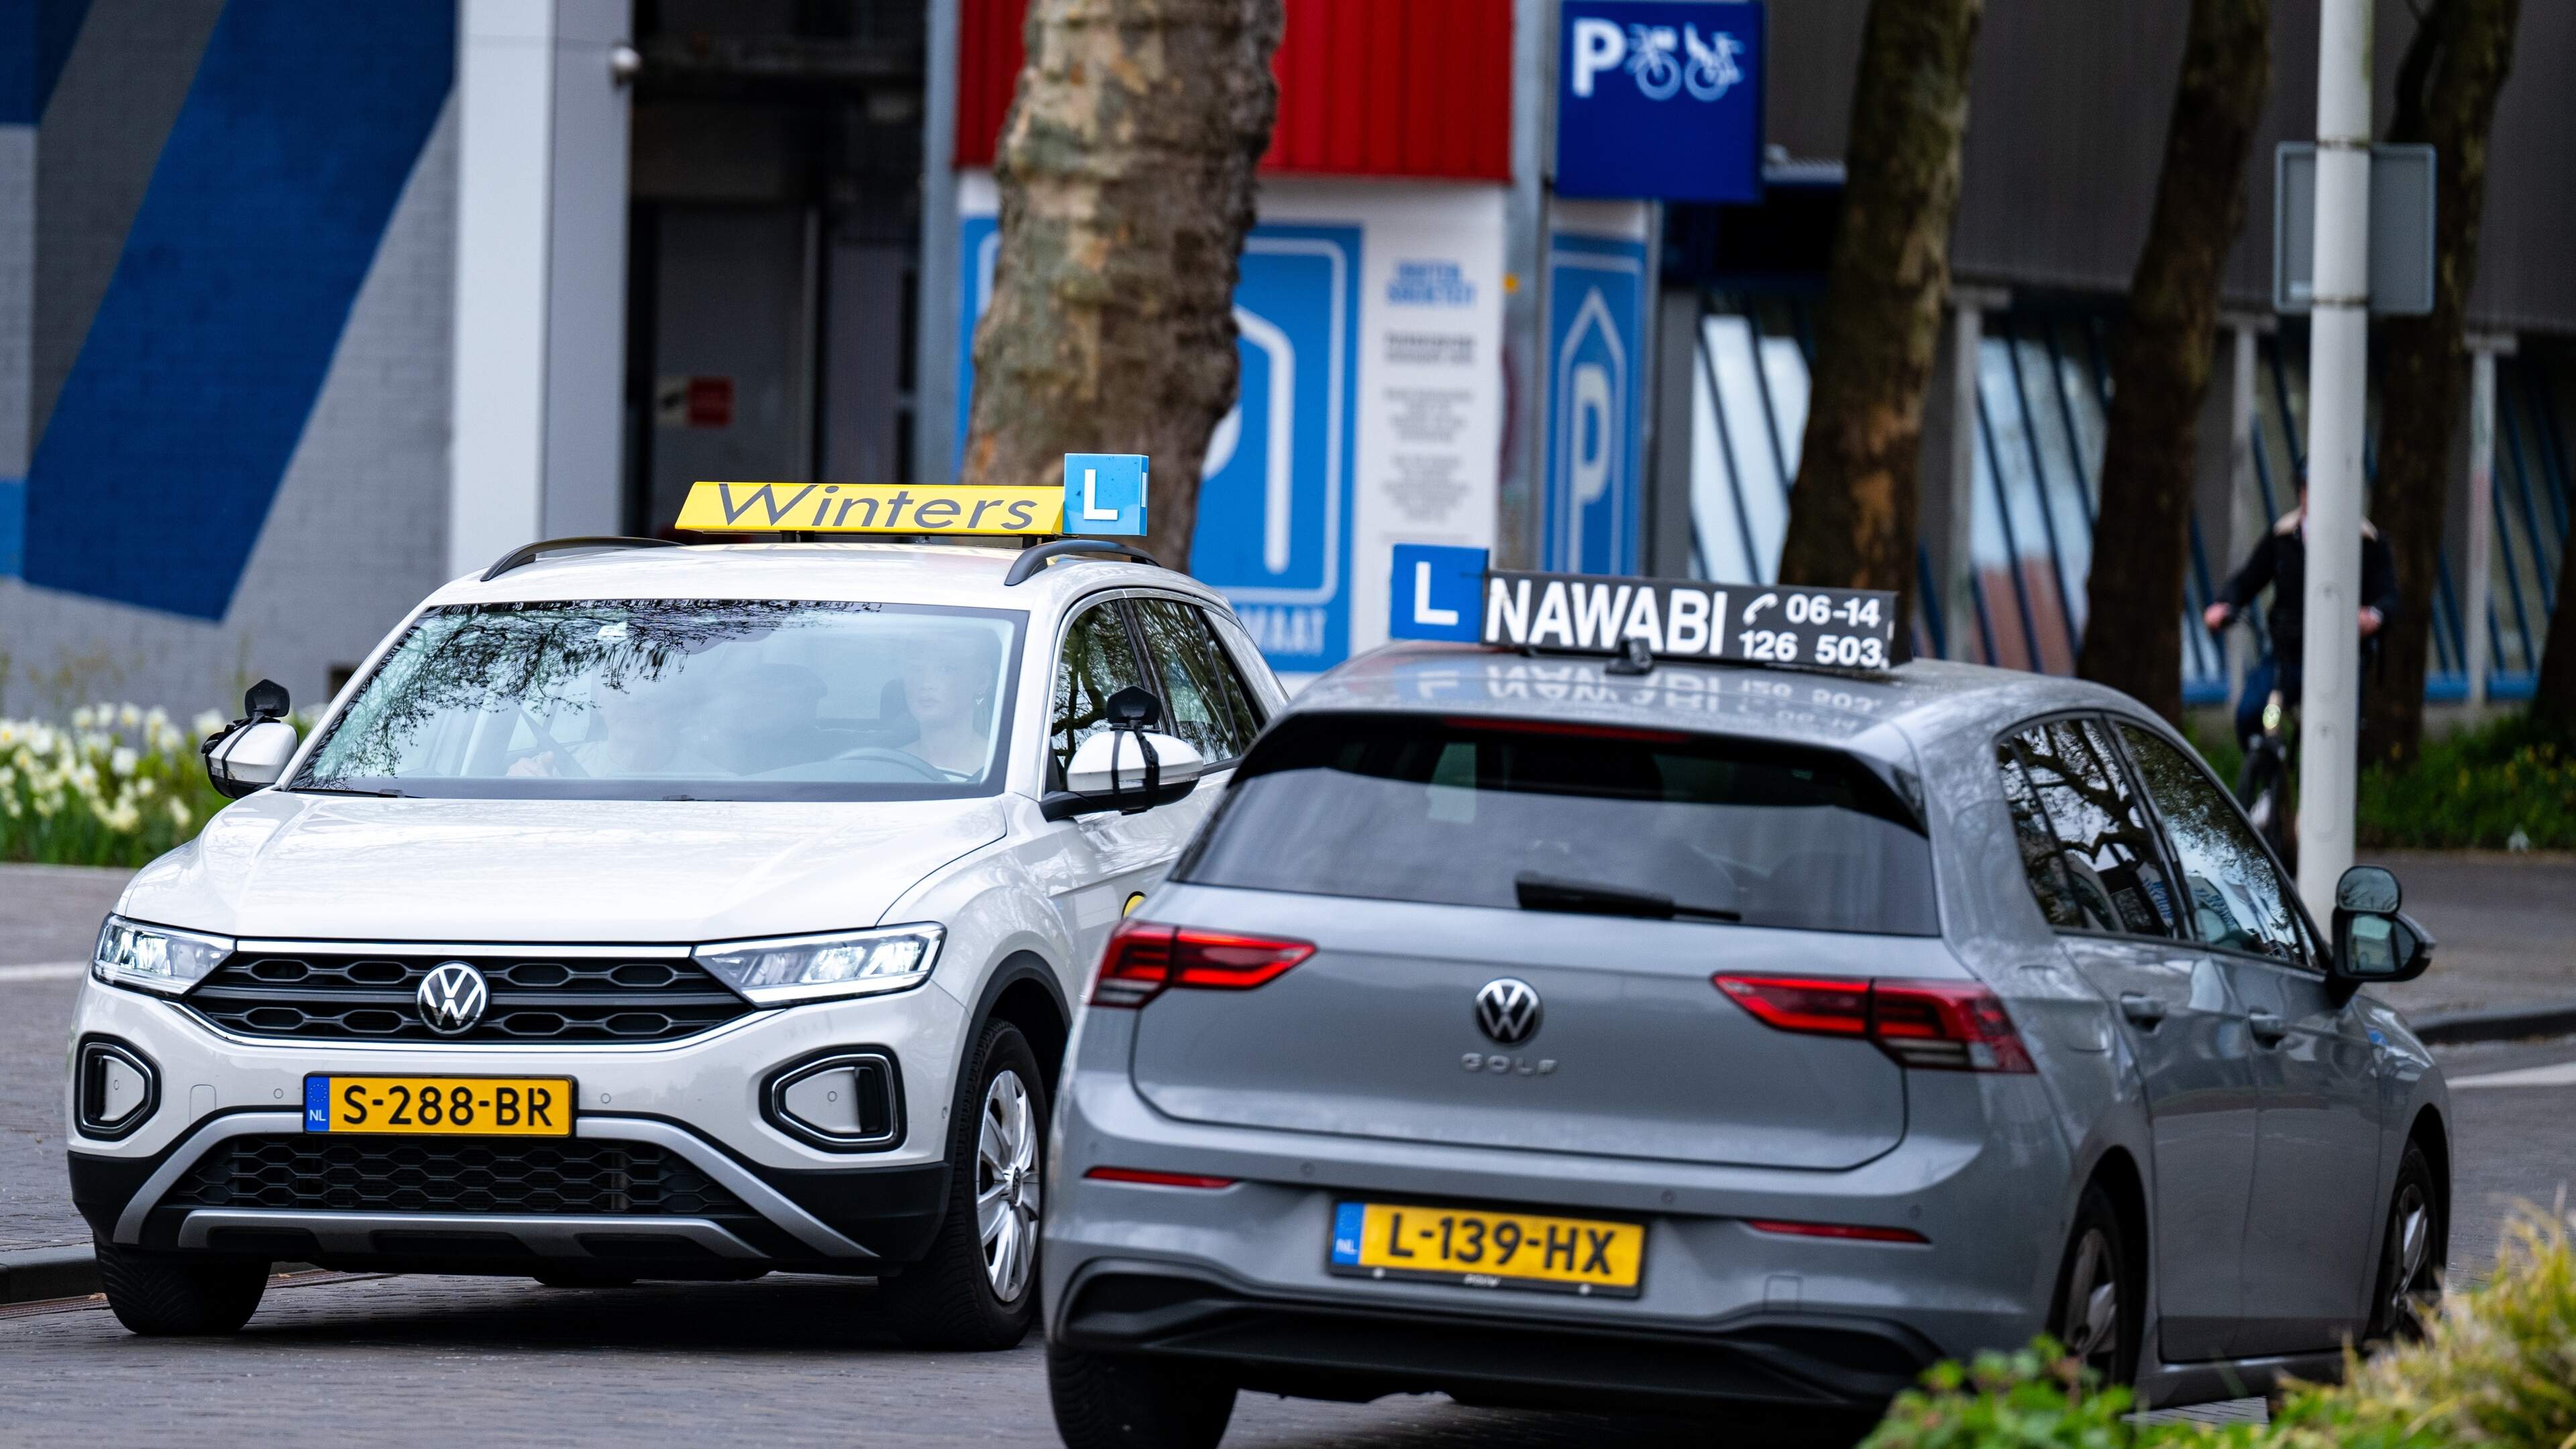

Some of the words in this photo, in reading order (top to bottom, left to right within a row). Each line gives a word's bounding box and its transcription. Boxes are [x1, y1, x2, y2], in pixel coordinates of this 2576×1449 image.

[1572, 17, 1628, 99] P
[718, 483, 1037, 530] Winters
[1084, 469, 1118, 521] L
[1414, 561, 1459, 626] L
[1485, 577, 1728, 656] NAWABI
[1786, 593, 1881, 628] 06-14
[1739, 630, 1799, 662] 126
[1461, 1053, 1558, 1076] GOLF
[309, 1109, 326, 1122] NL
[343, 1085, 552, 1127] S-288-BR
[1389, 1213, 1615, 1275] L-139-HX
